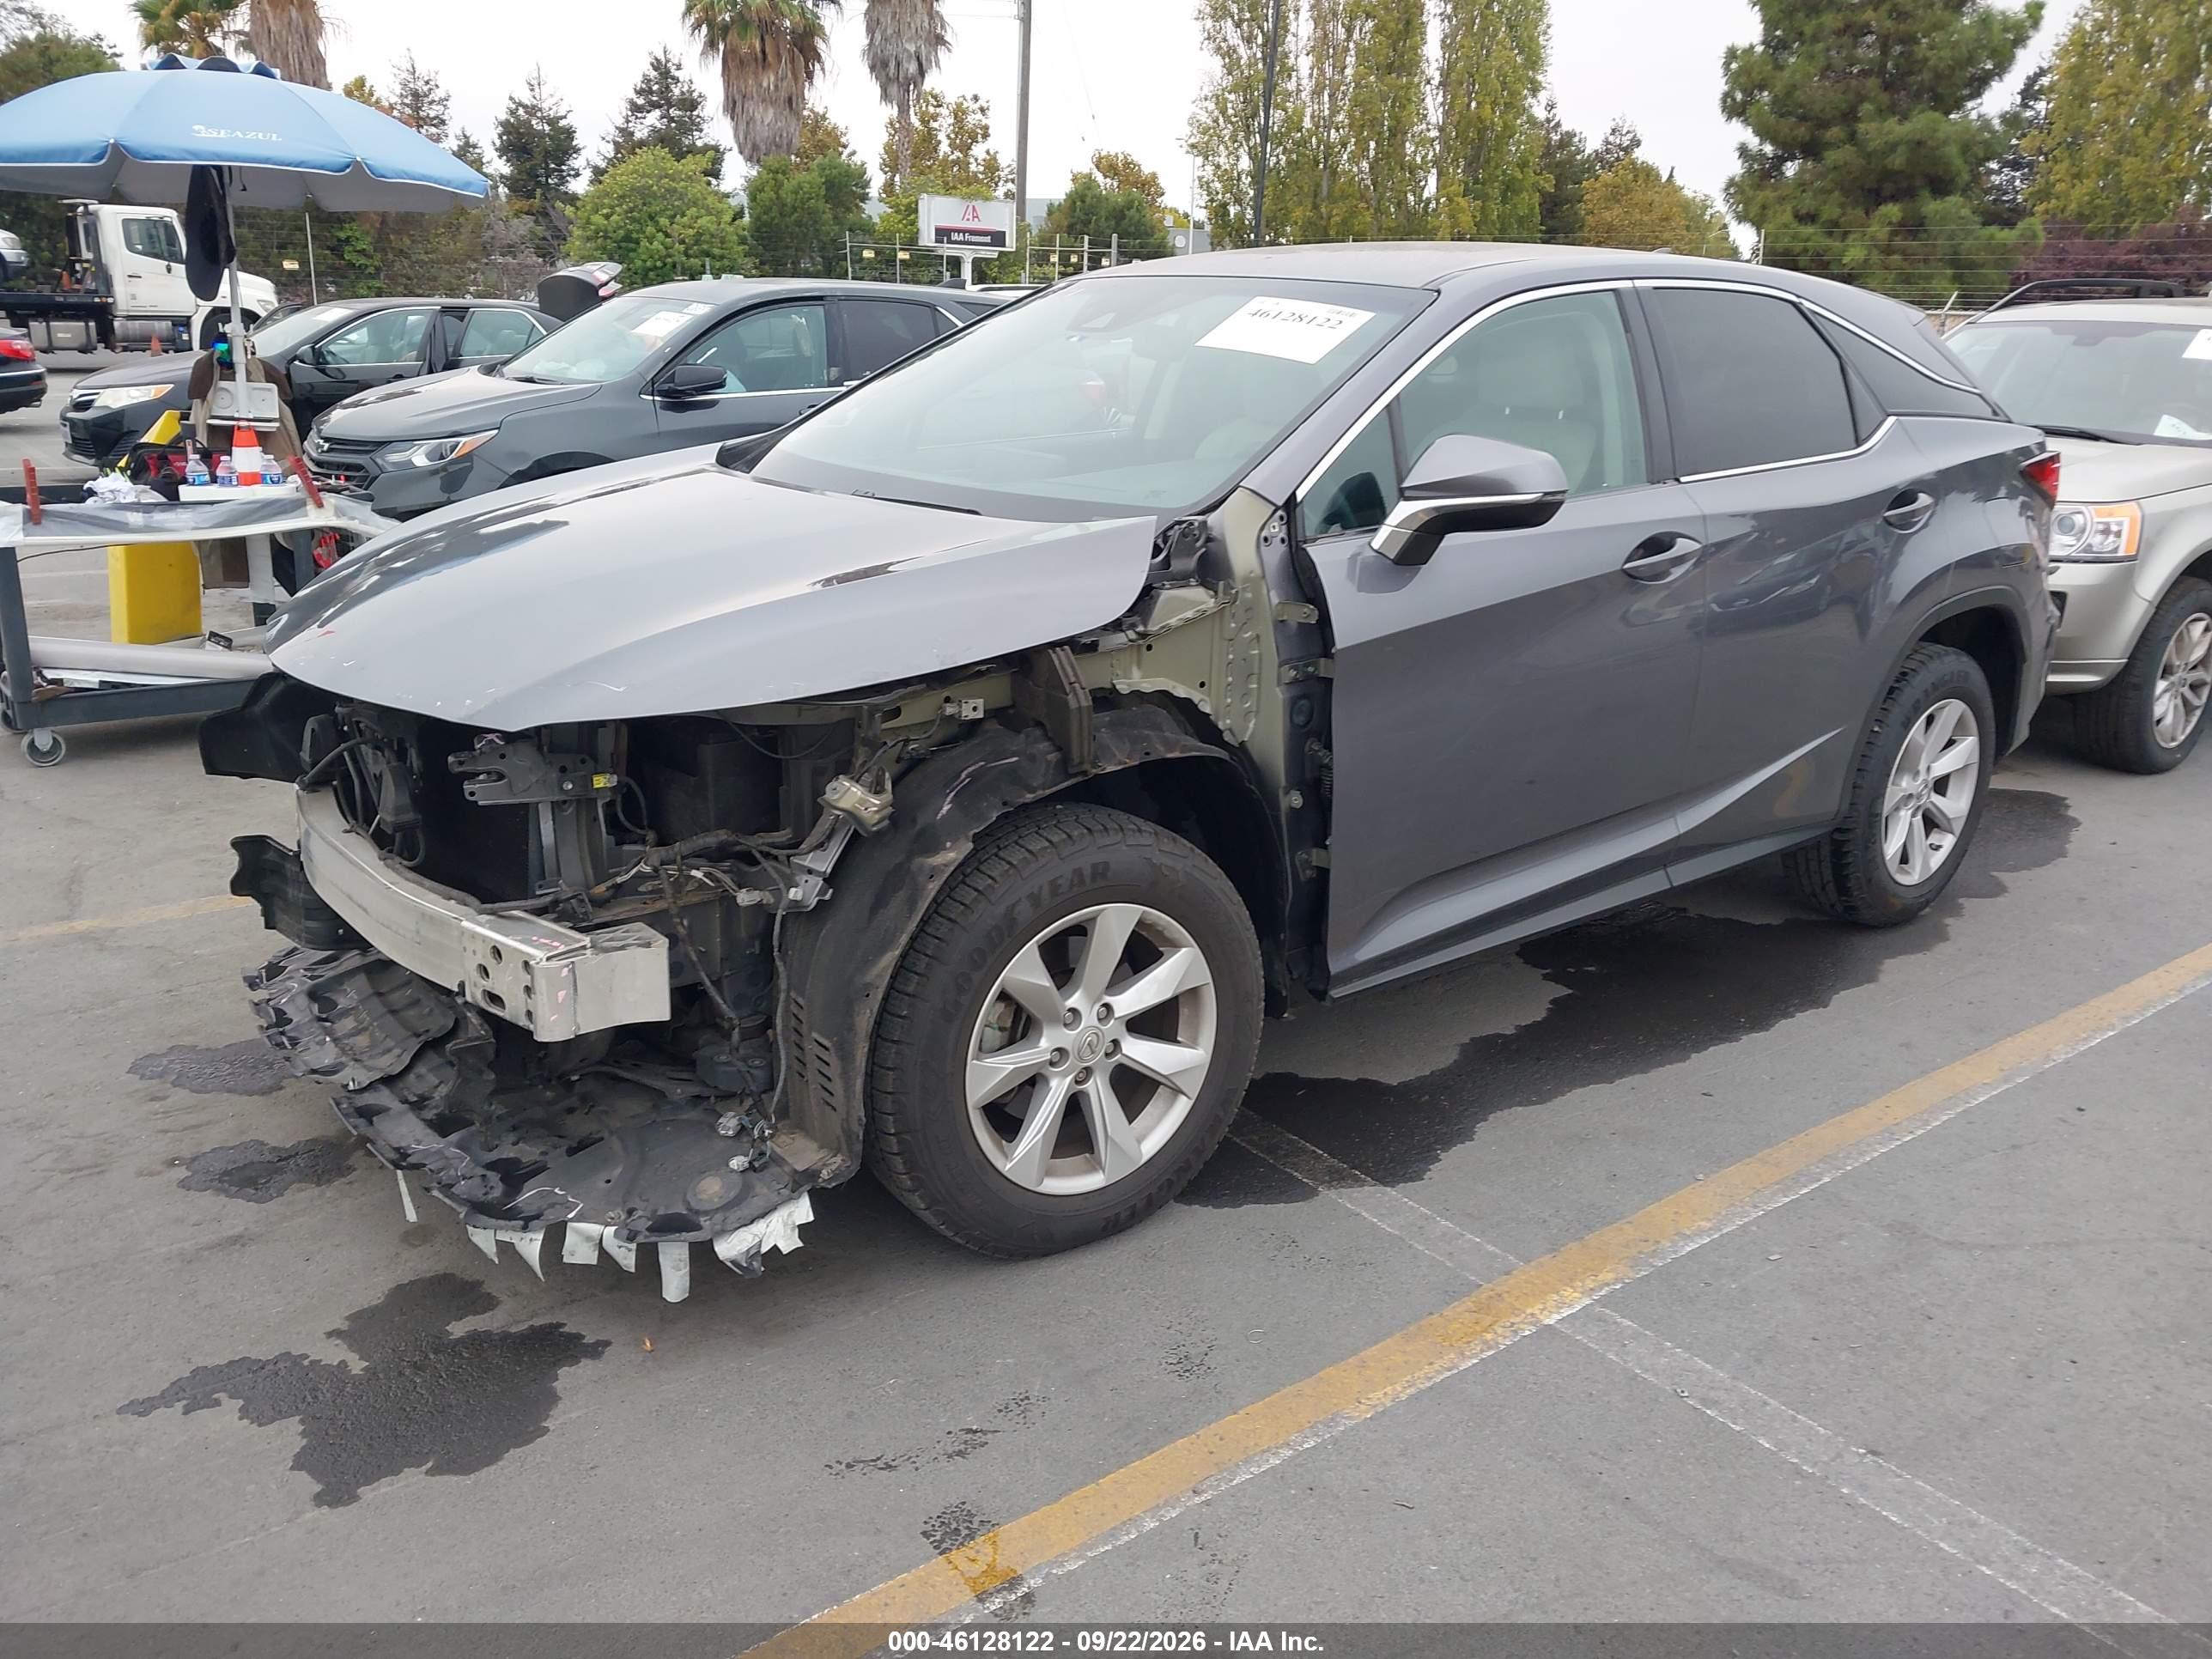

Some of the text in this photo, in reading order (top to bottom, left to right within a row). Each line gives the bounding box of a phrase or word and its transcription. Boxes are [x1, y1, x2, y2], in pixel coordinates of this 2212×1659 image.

[205, 128, 283, 142] SEAZUL
[951, 232, 963, 241] IAA
[1248, 308, 1344, 330] 46128122
